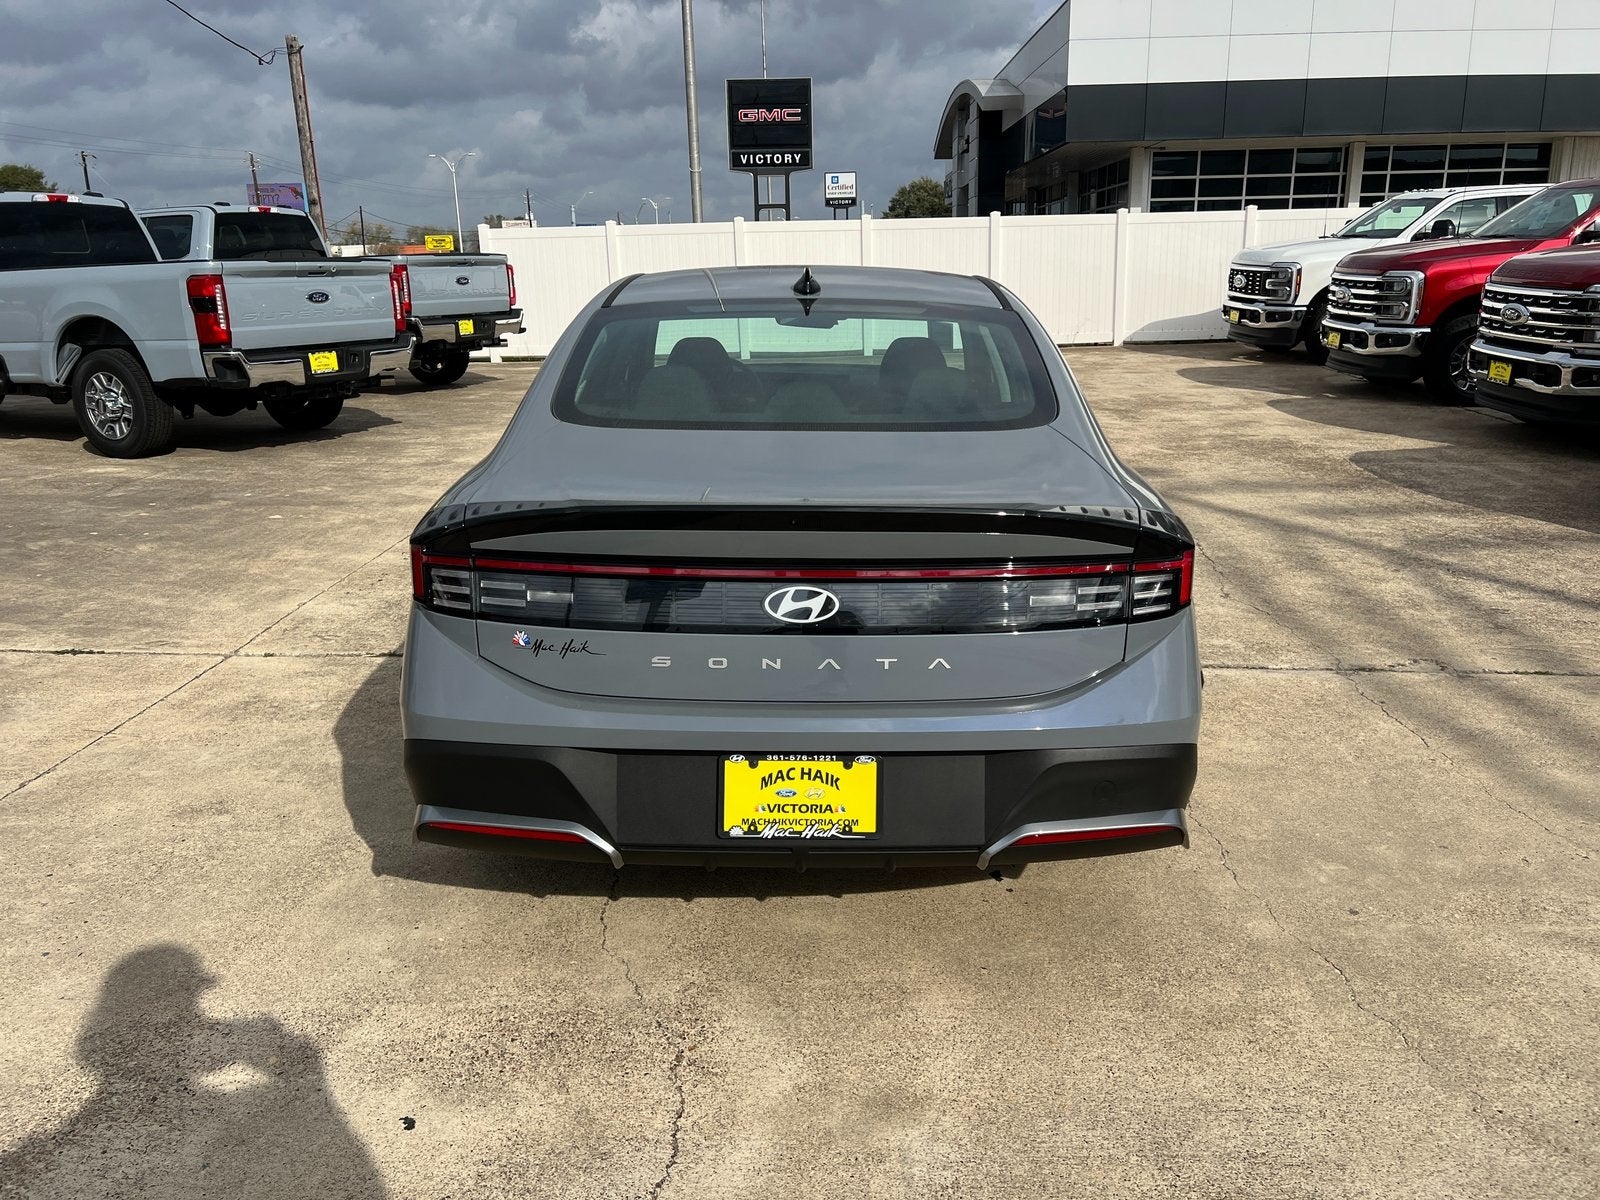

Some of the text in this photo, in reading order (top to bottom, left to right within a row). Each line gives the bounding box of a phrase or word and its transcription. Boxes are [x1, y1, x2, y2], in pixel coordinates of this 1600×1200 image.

[738, 109, 801, 122] GMC
[740, 154, 801, 164] VICTORY
[242, 309, 327, 321] SUPER
[530, 638, 594, 660] Mac Haik
[651, 656, 952, 671] SONATA
[760, 767, 840, 791] MAC HAIK
[767, 804, 833, 814] VICTORIA
[742, 818, 859, 827] MACHAIKVICTORIA.COM
[760, 822, 844, 839] Mac Haik
